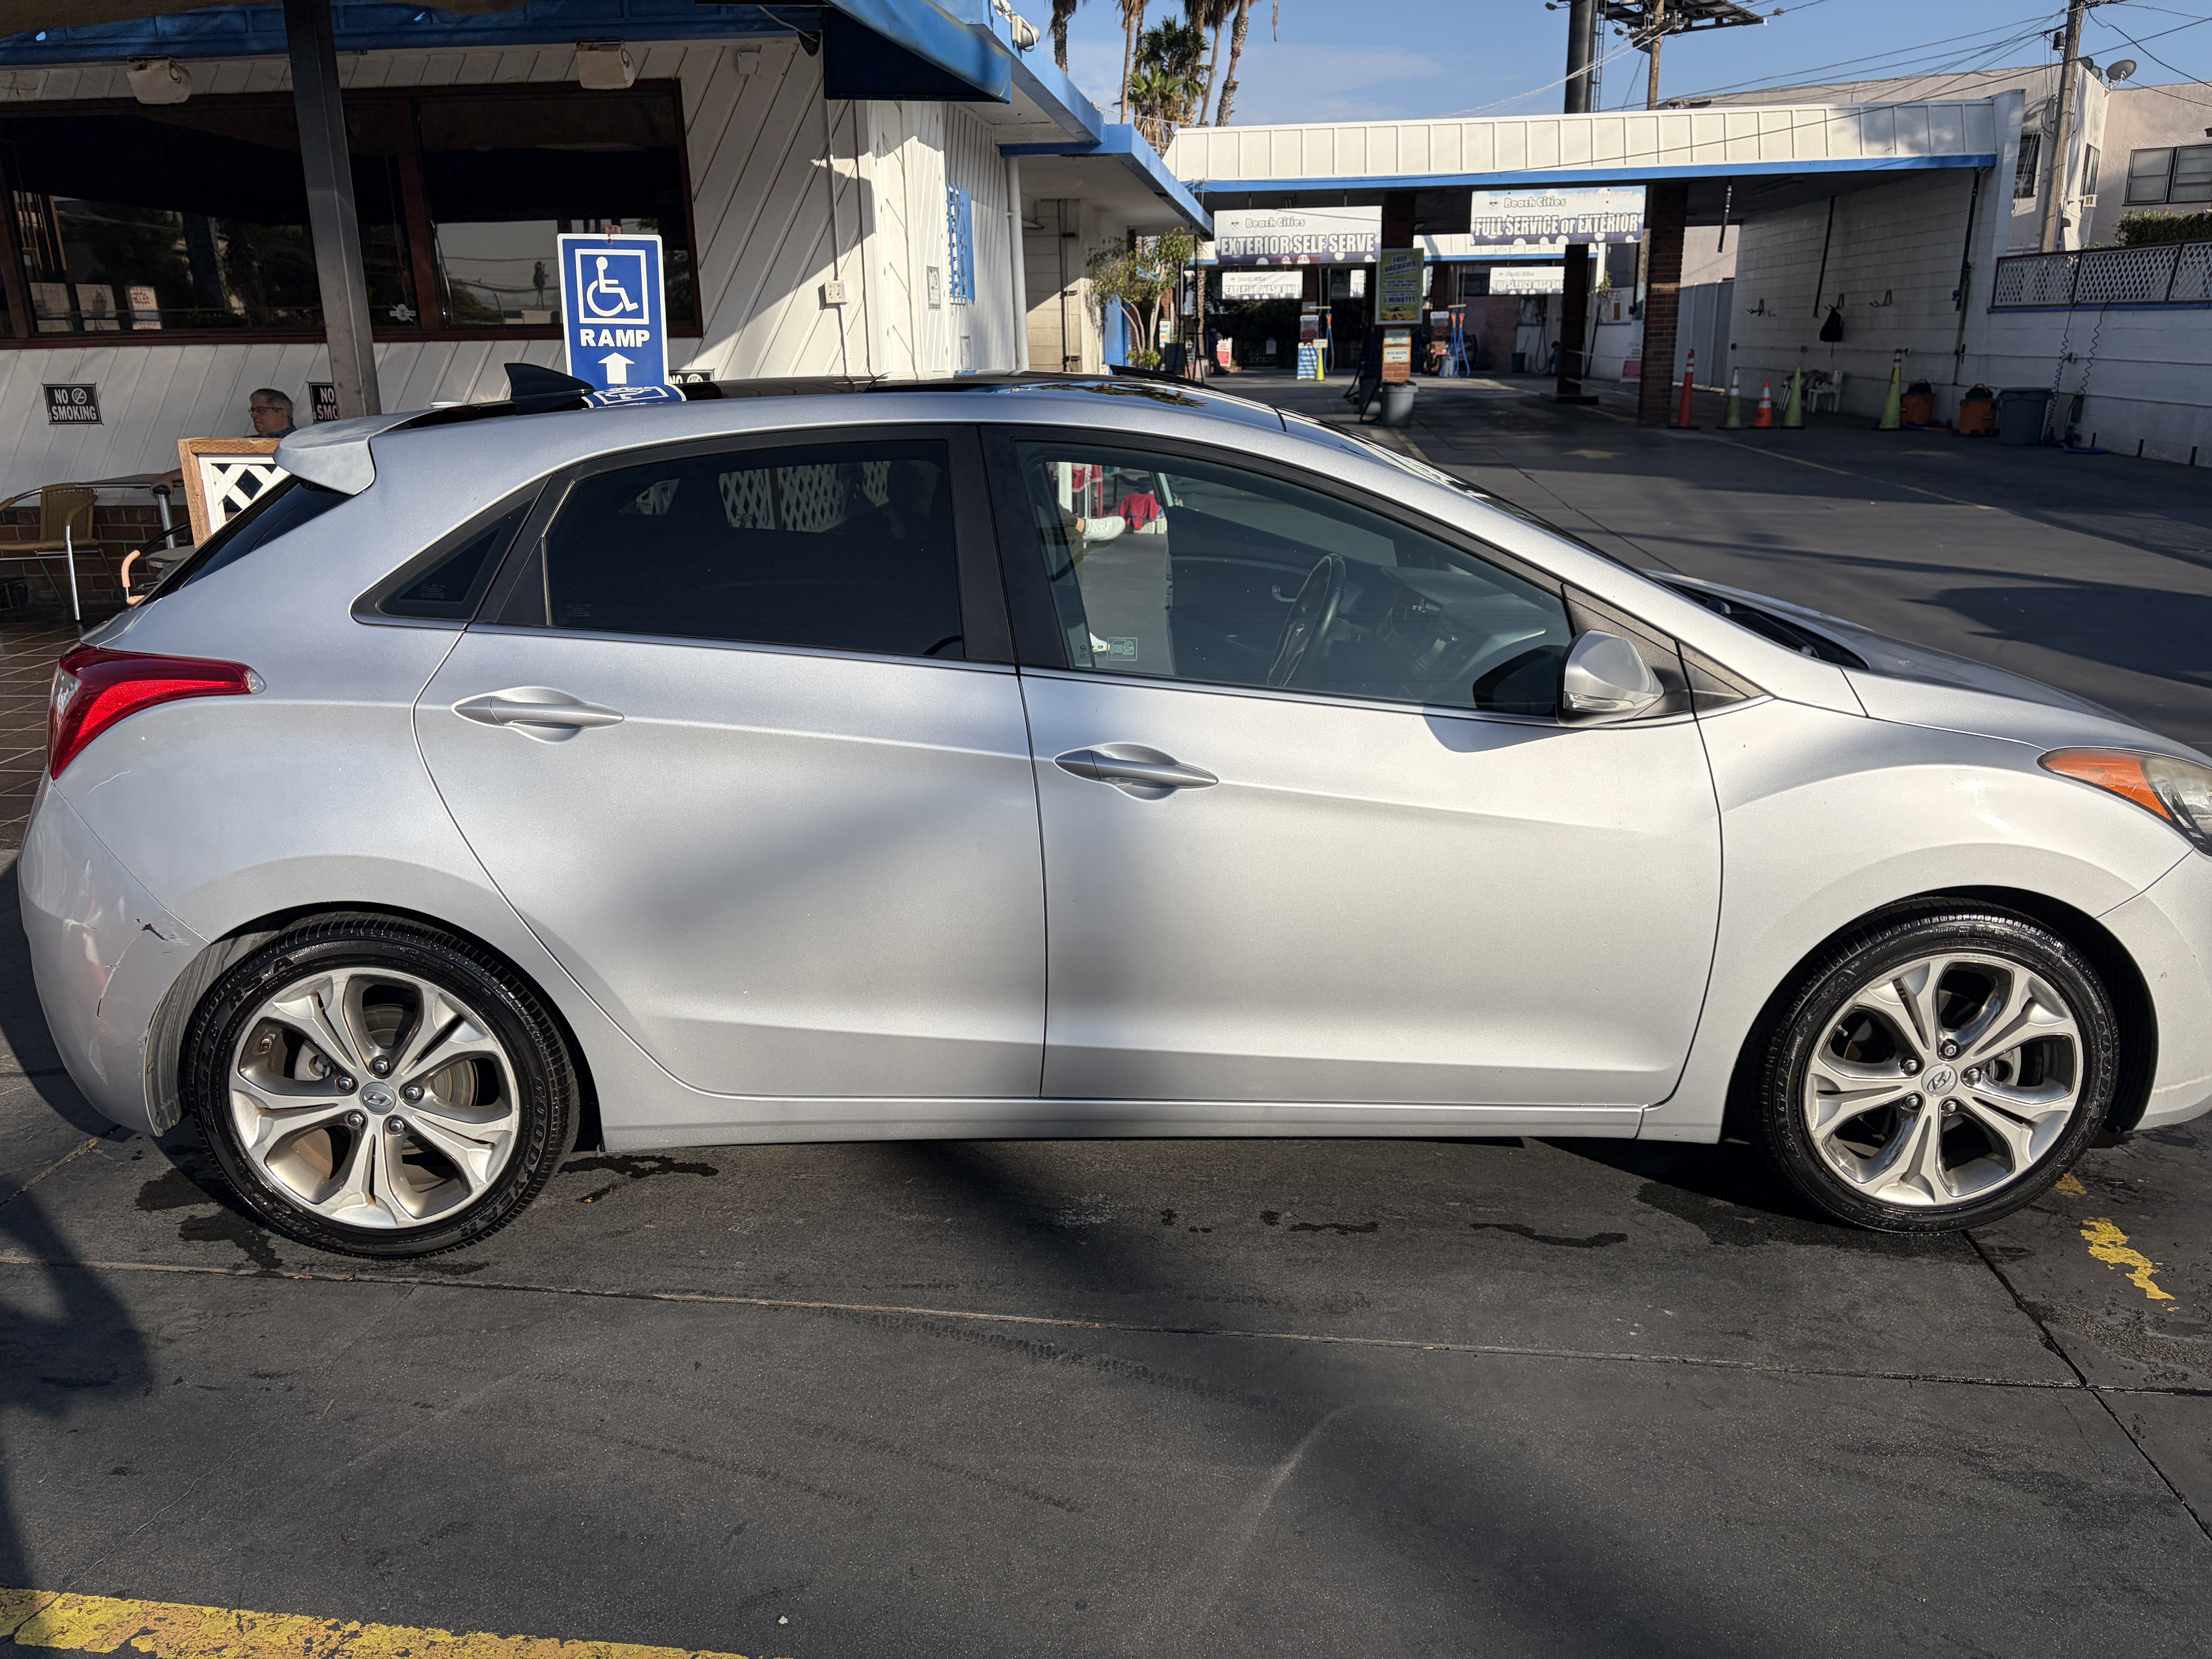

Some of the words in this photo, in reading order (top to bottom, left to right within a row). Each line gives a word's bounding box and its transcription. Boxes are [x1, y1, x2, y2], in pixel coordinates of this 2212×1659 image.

[1504, 196, 1535, 208] Beach
[1536, 196, 1566, 207] Cities
[1245, 217, 1276, 228] Beach
[1278, 216, 1305, 227] Cities
[1475, 216, 1502, 236] FULL
[1504, 215, 1559, 236] SERVICE
[1560, 218, 1576, 234] or
[1577, 213, 1638, 234] EXTERIOR
[1220, 235, 1291, 256] EXTERIOR
[1292, 234, 1327, 254] SELF
[1328, 233, 1375, 253] SERVE
[580, 328, 650, 348] RAMP
[54, 389, 69, 404] NO
[320, 387, 335, 403] NO
[52, 405, 97, 421] SMOKING
[2040, 1013, 2112, 1183] GOODYEAR
[459, 1077, 547, 1238] GOODYEAR
